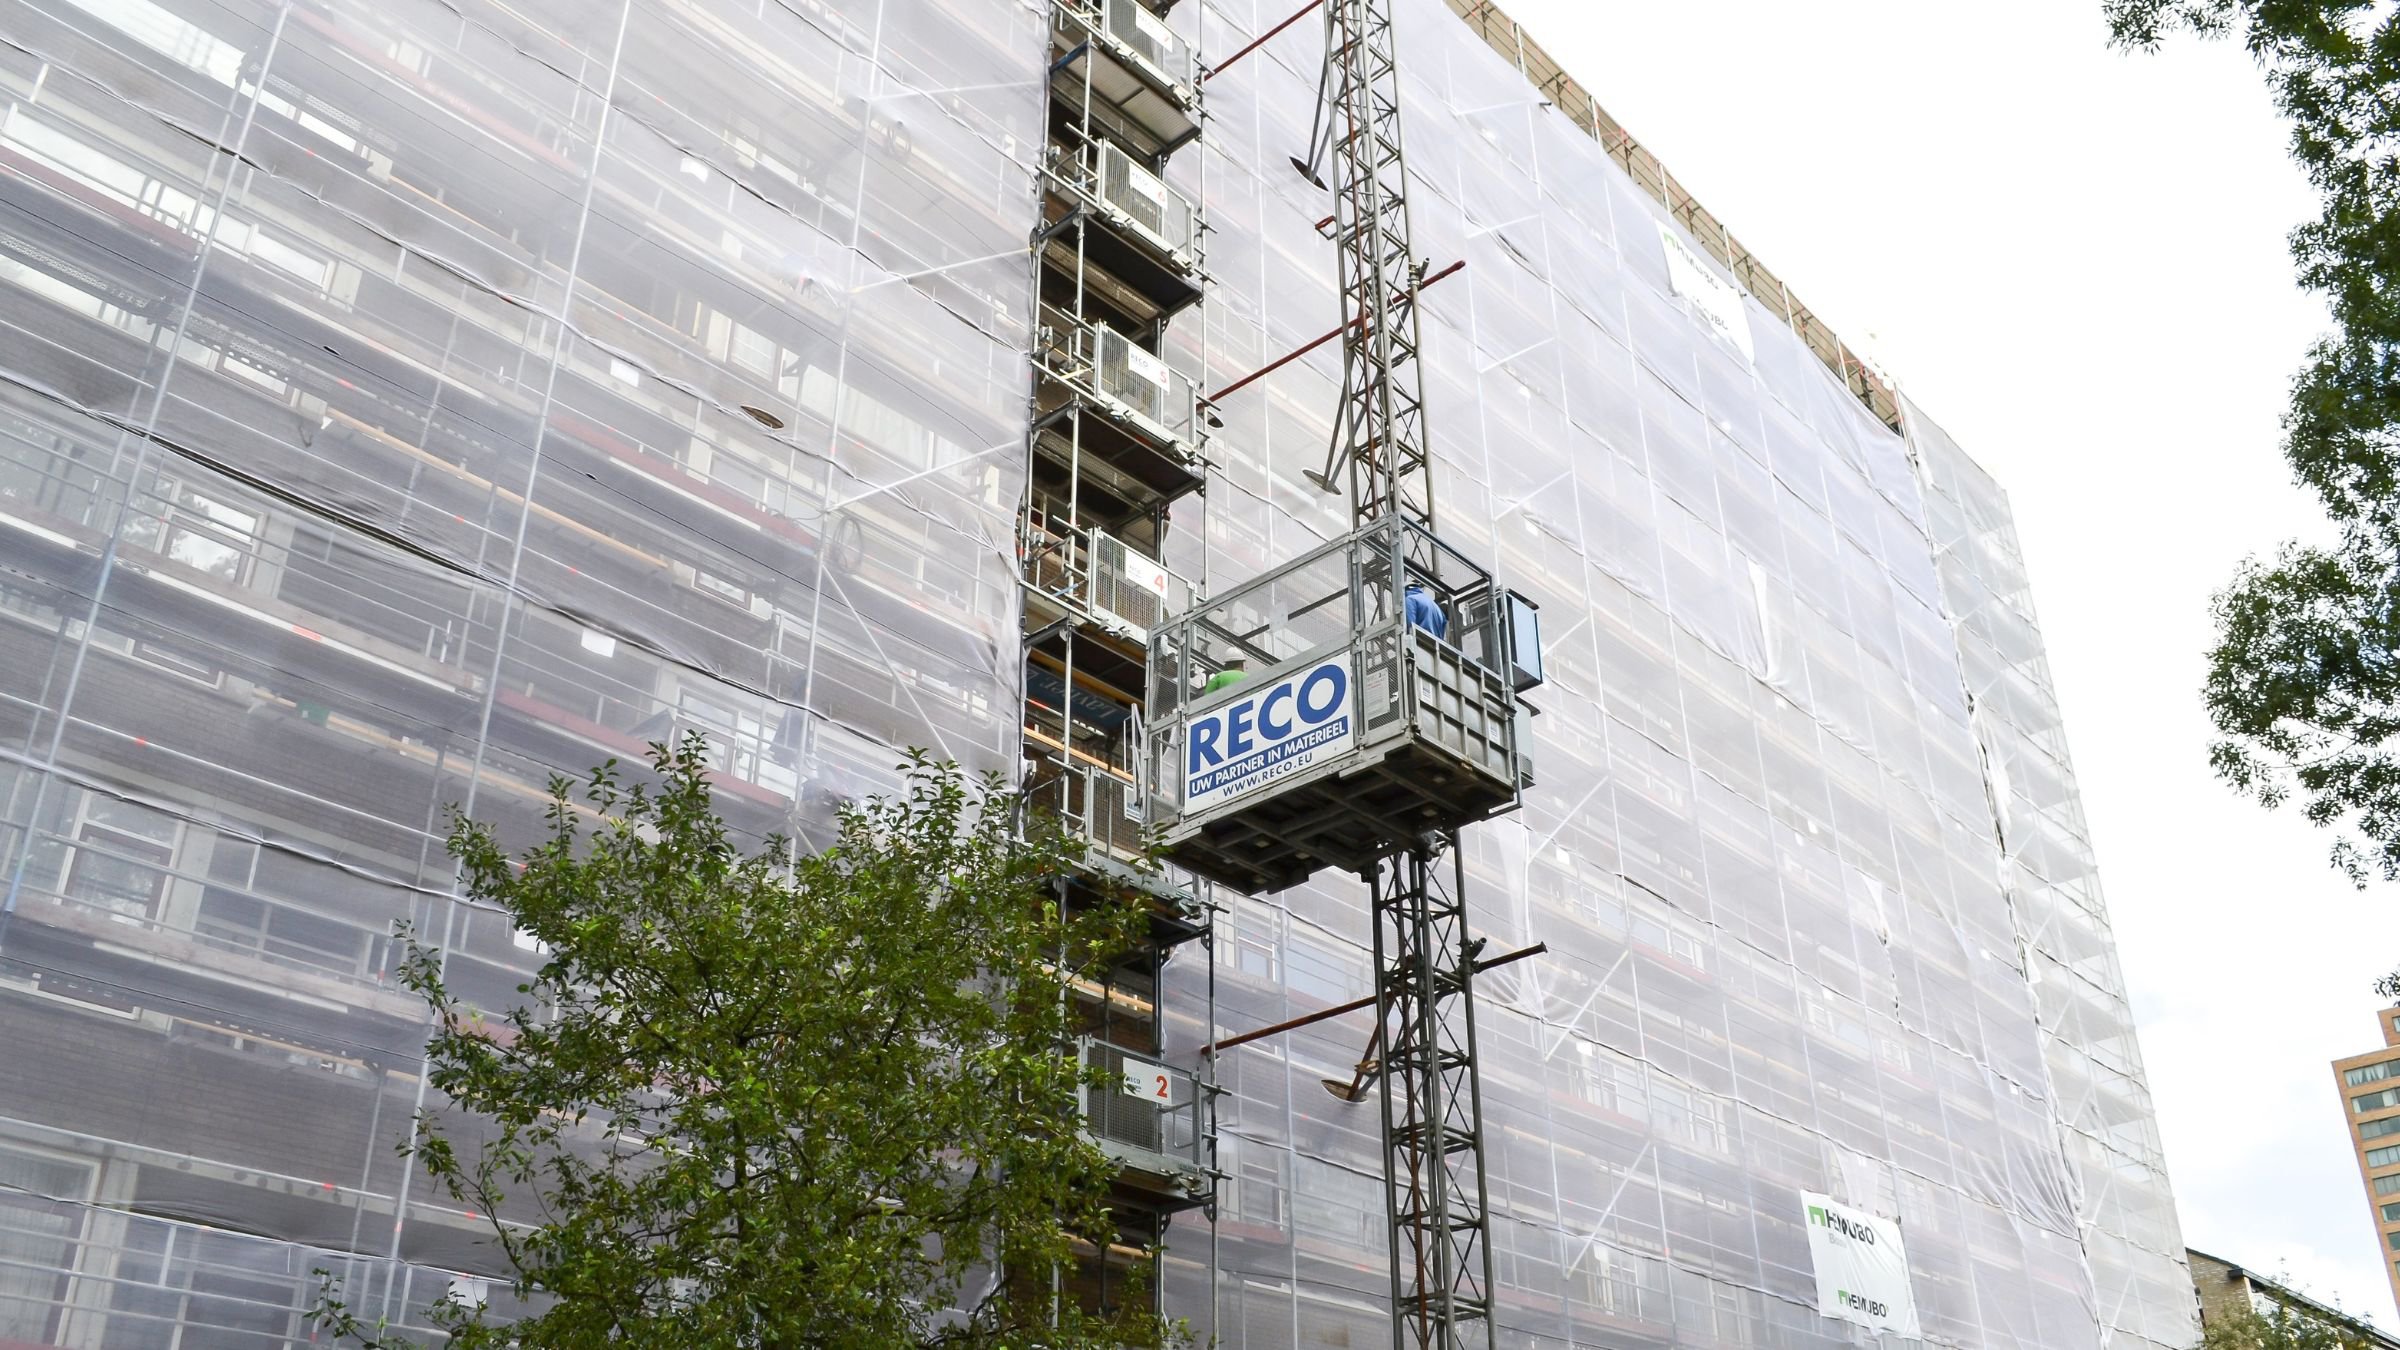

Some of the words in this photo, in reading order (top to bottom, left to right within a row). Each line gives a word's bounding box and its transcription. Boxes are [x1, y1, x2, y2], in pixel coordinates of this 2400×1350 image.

[1153, 574, 1164, 592] 4
[1189, 664, 1347, 775] RECO
[1191, 775, 1213, 794] UW
[1215, 754, 1265, 786] PARTNER
[1267, 746, 1281, 763] IN
[1284, 720, 1346, 757] MATERIEEL
[1223, 752, 1313, 797] WWW.RECO.EU
[1156, 1073, 1168, 1098] 2
